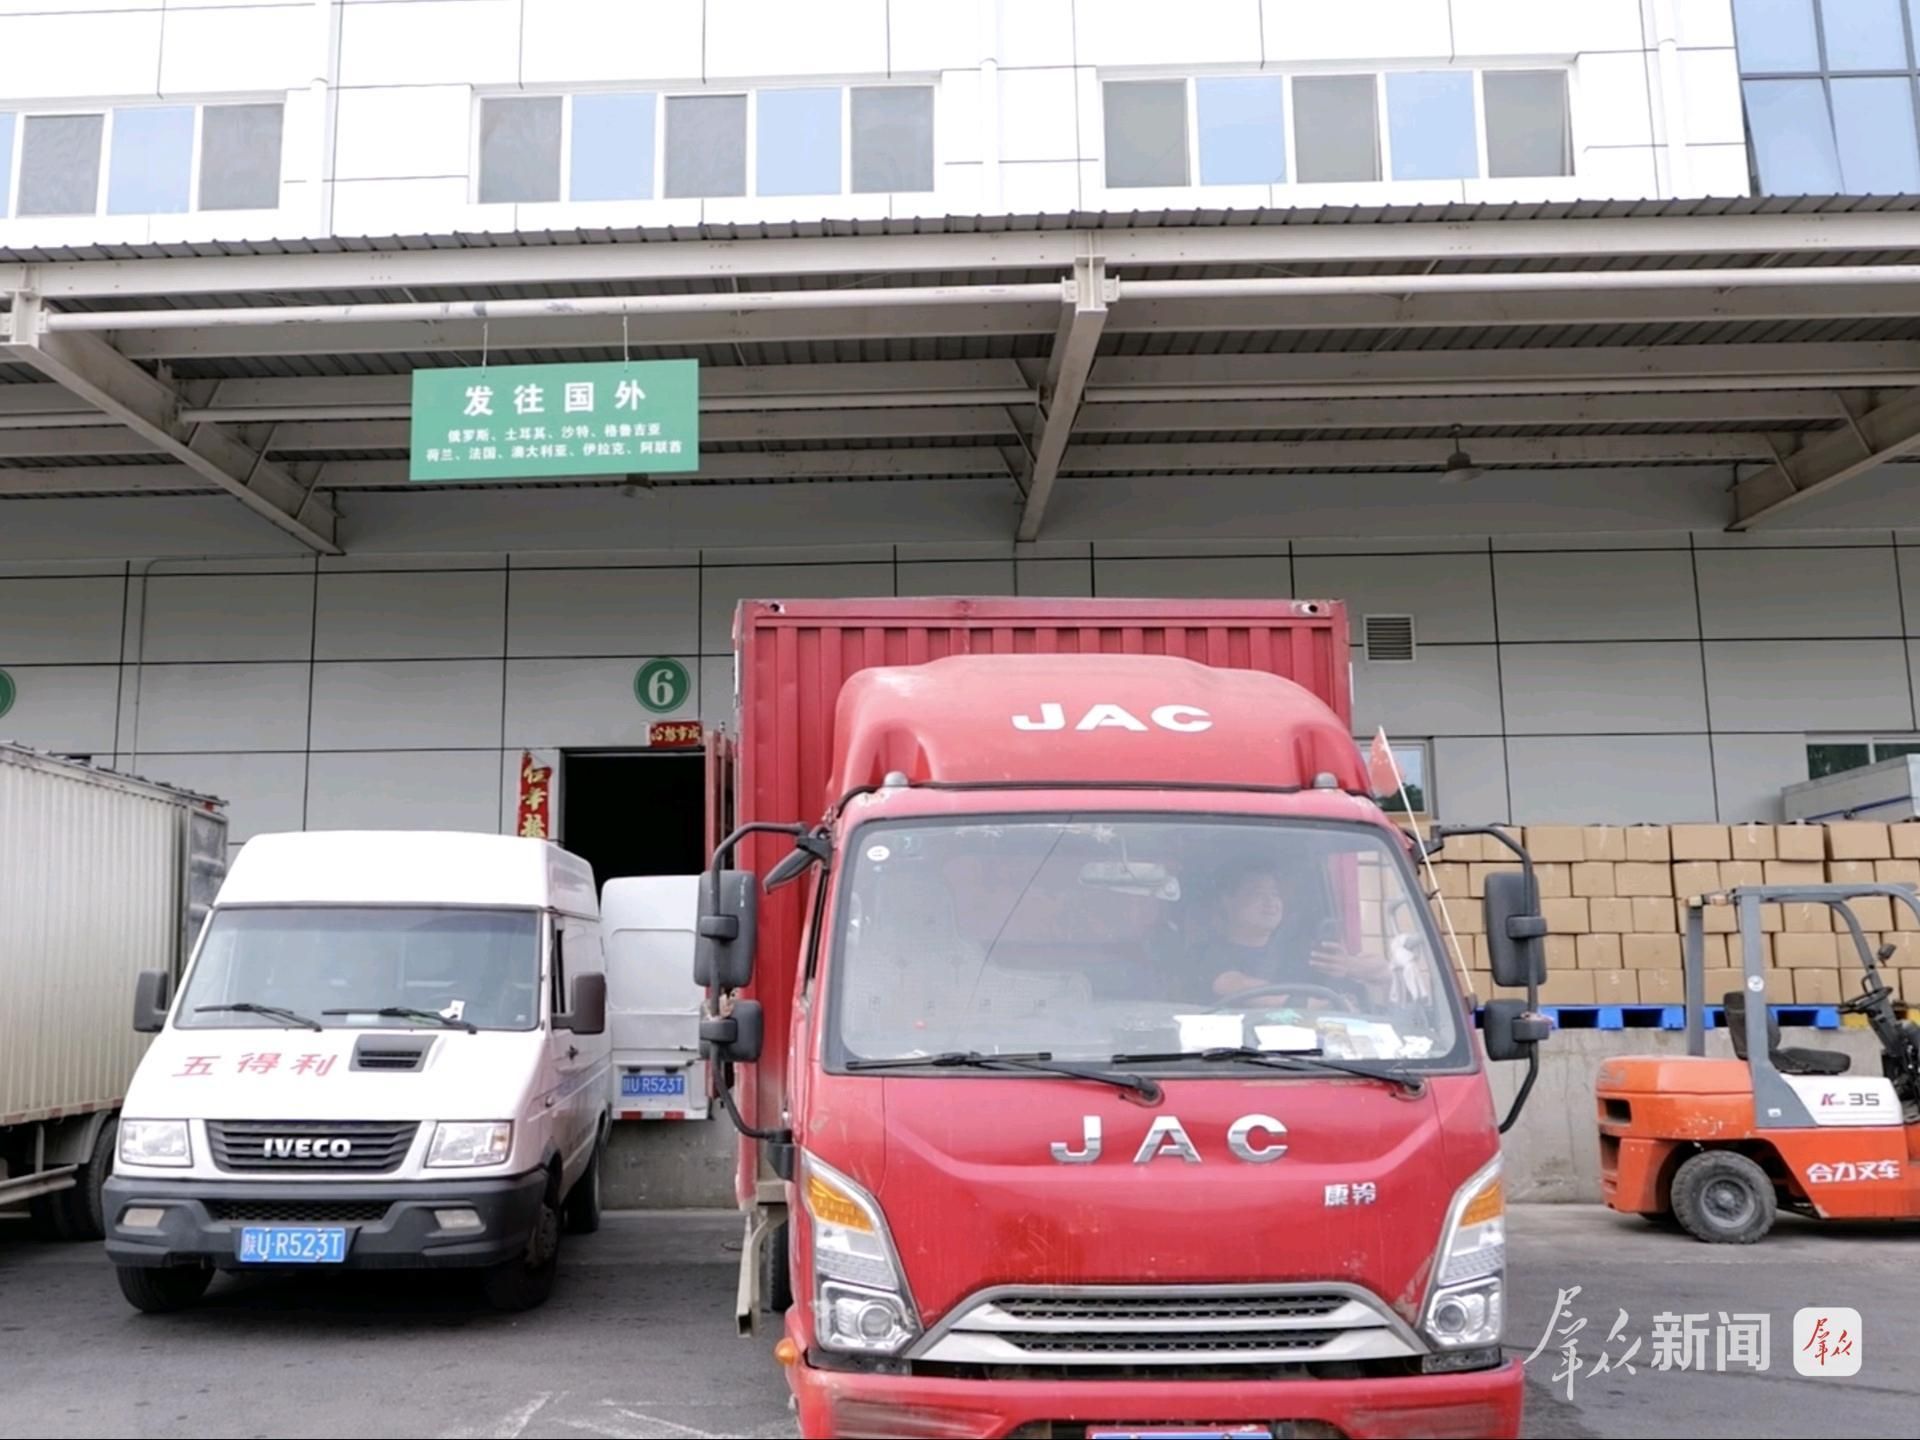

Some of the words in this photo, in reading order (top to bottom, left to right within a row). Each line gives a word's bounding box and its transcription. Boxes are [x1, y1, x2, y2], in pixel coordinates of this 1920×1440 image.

[464, 379, 646, 417] 发往国外
[648, 669, 675, 706] 6
[1011, 703, 1214, 733] JAC
[171, 1052, 339, 1077] 五得利
[1848, 1093, 1880, 1106] 35
[263, 1138, 351, 1158] IVECO
[1050, 1113, 1288, 1164] JAC
[1806, 1160, 1900, 1184] 合力叉车
[1324, 1182, 1376, 1206] 康铃
